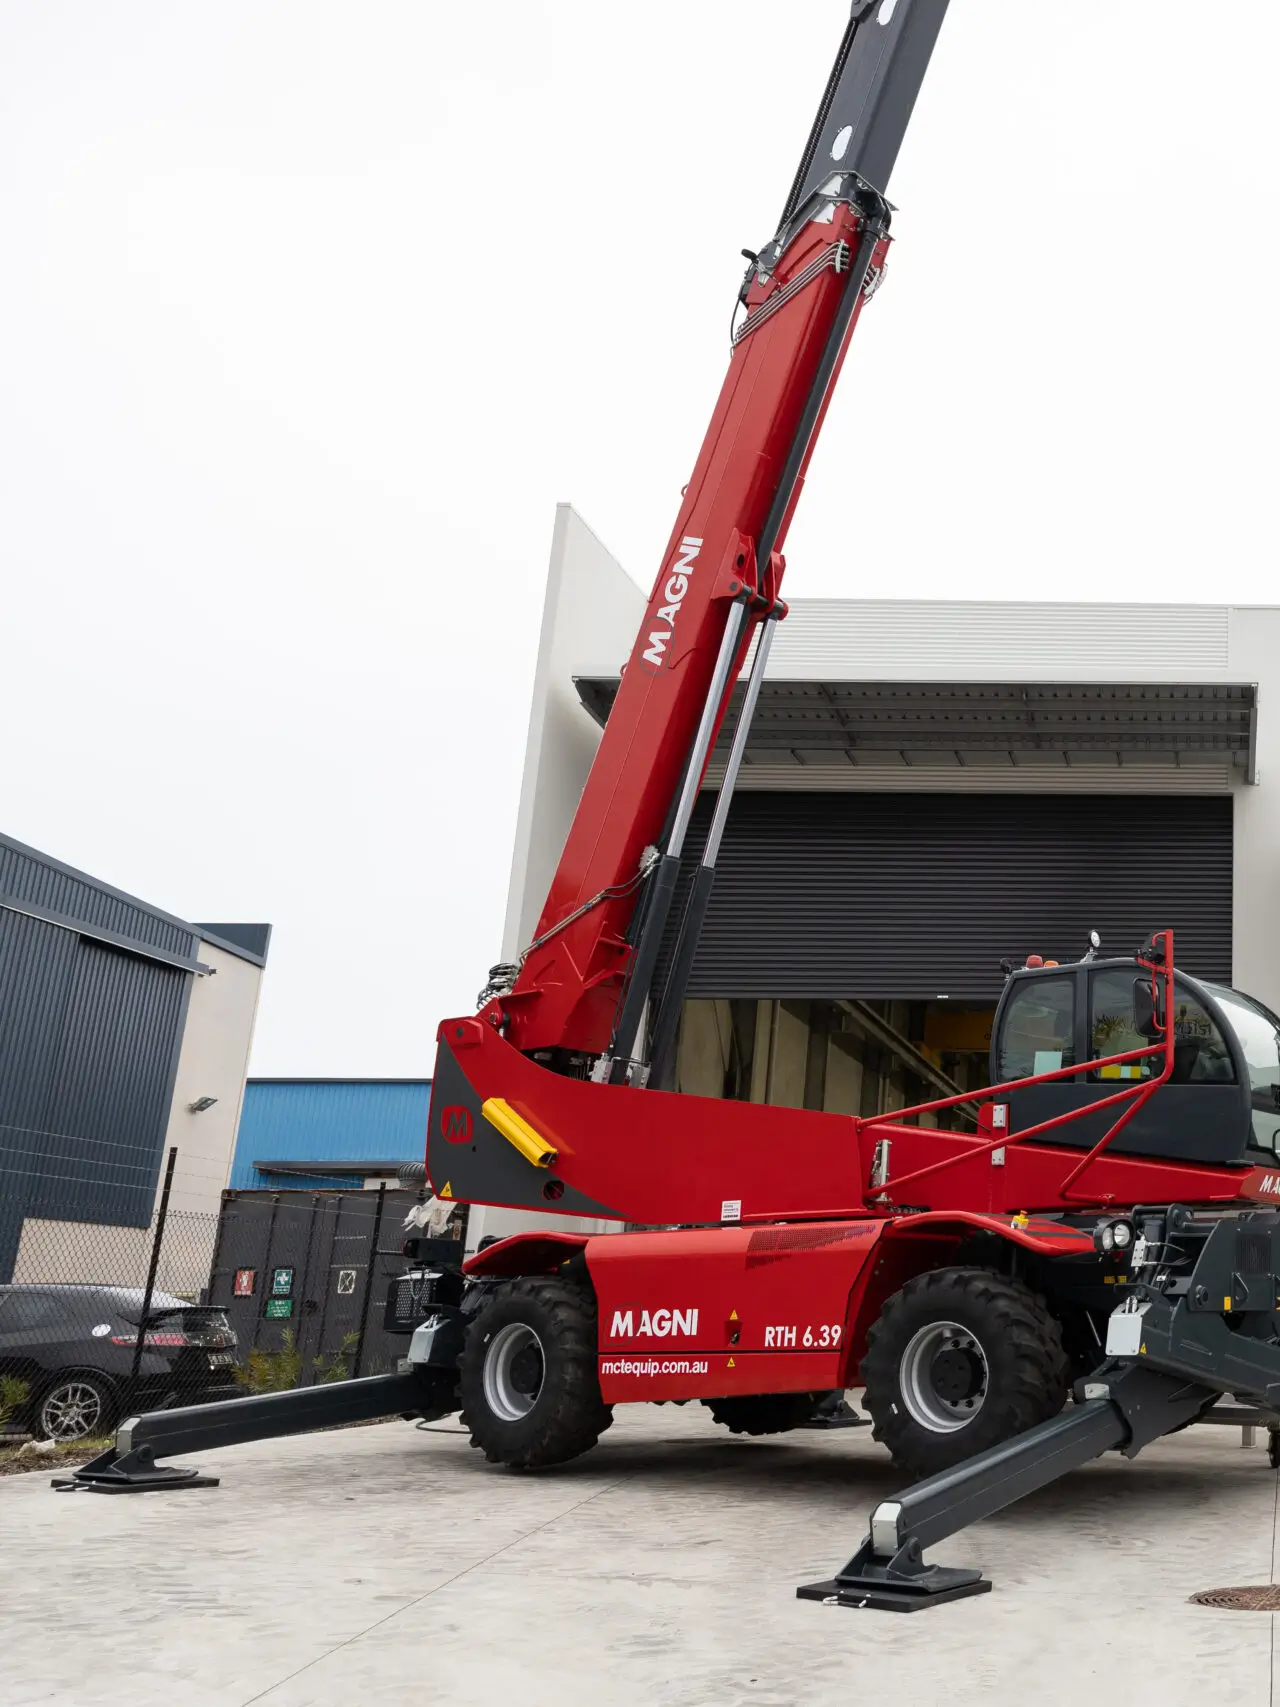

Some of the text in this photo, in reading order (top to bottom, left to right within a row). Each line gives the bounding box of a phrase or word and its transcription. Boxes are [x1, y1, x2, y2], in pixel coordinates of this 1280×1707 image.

[642, 536, 704, 666] MAGNI
[610, 1308, 699, 1338] MAGNI
[764, 1324, 842, 1348] RTH 6.39
[601, 1358, 709, 1377] mctequip.com.au
